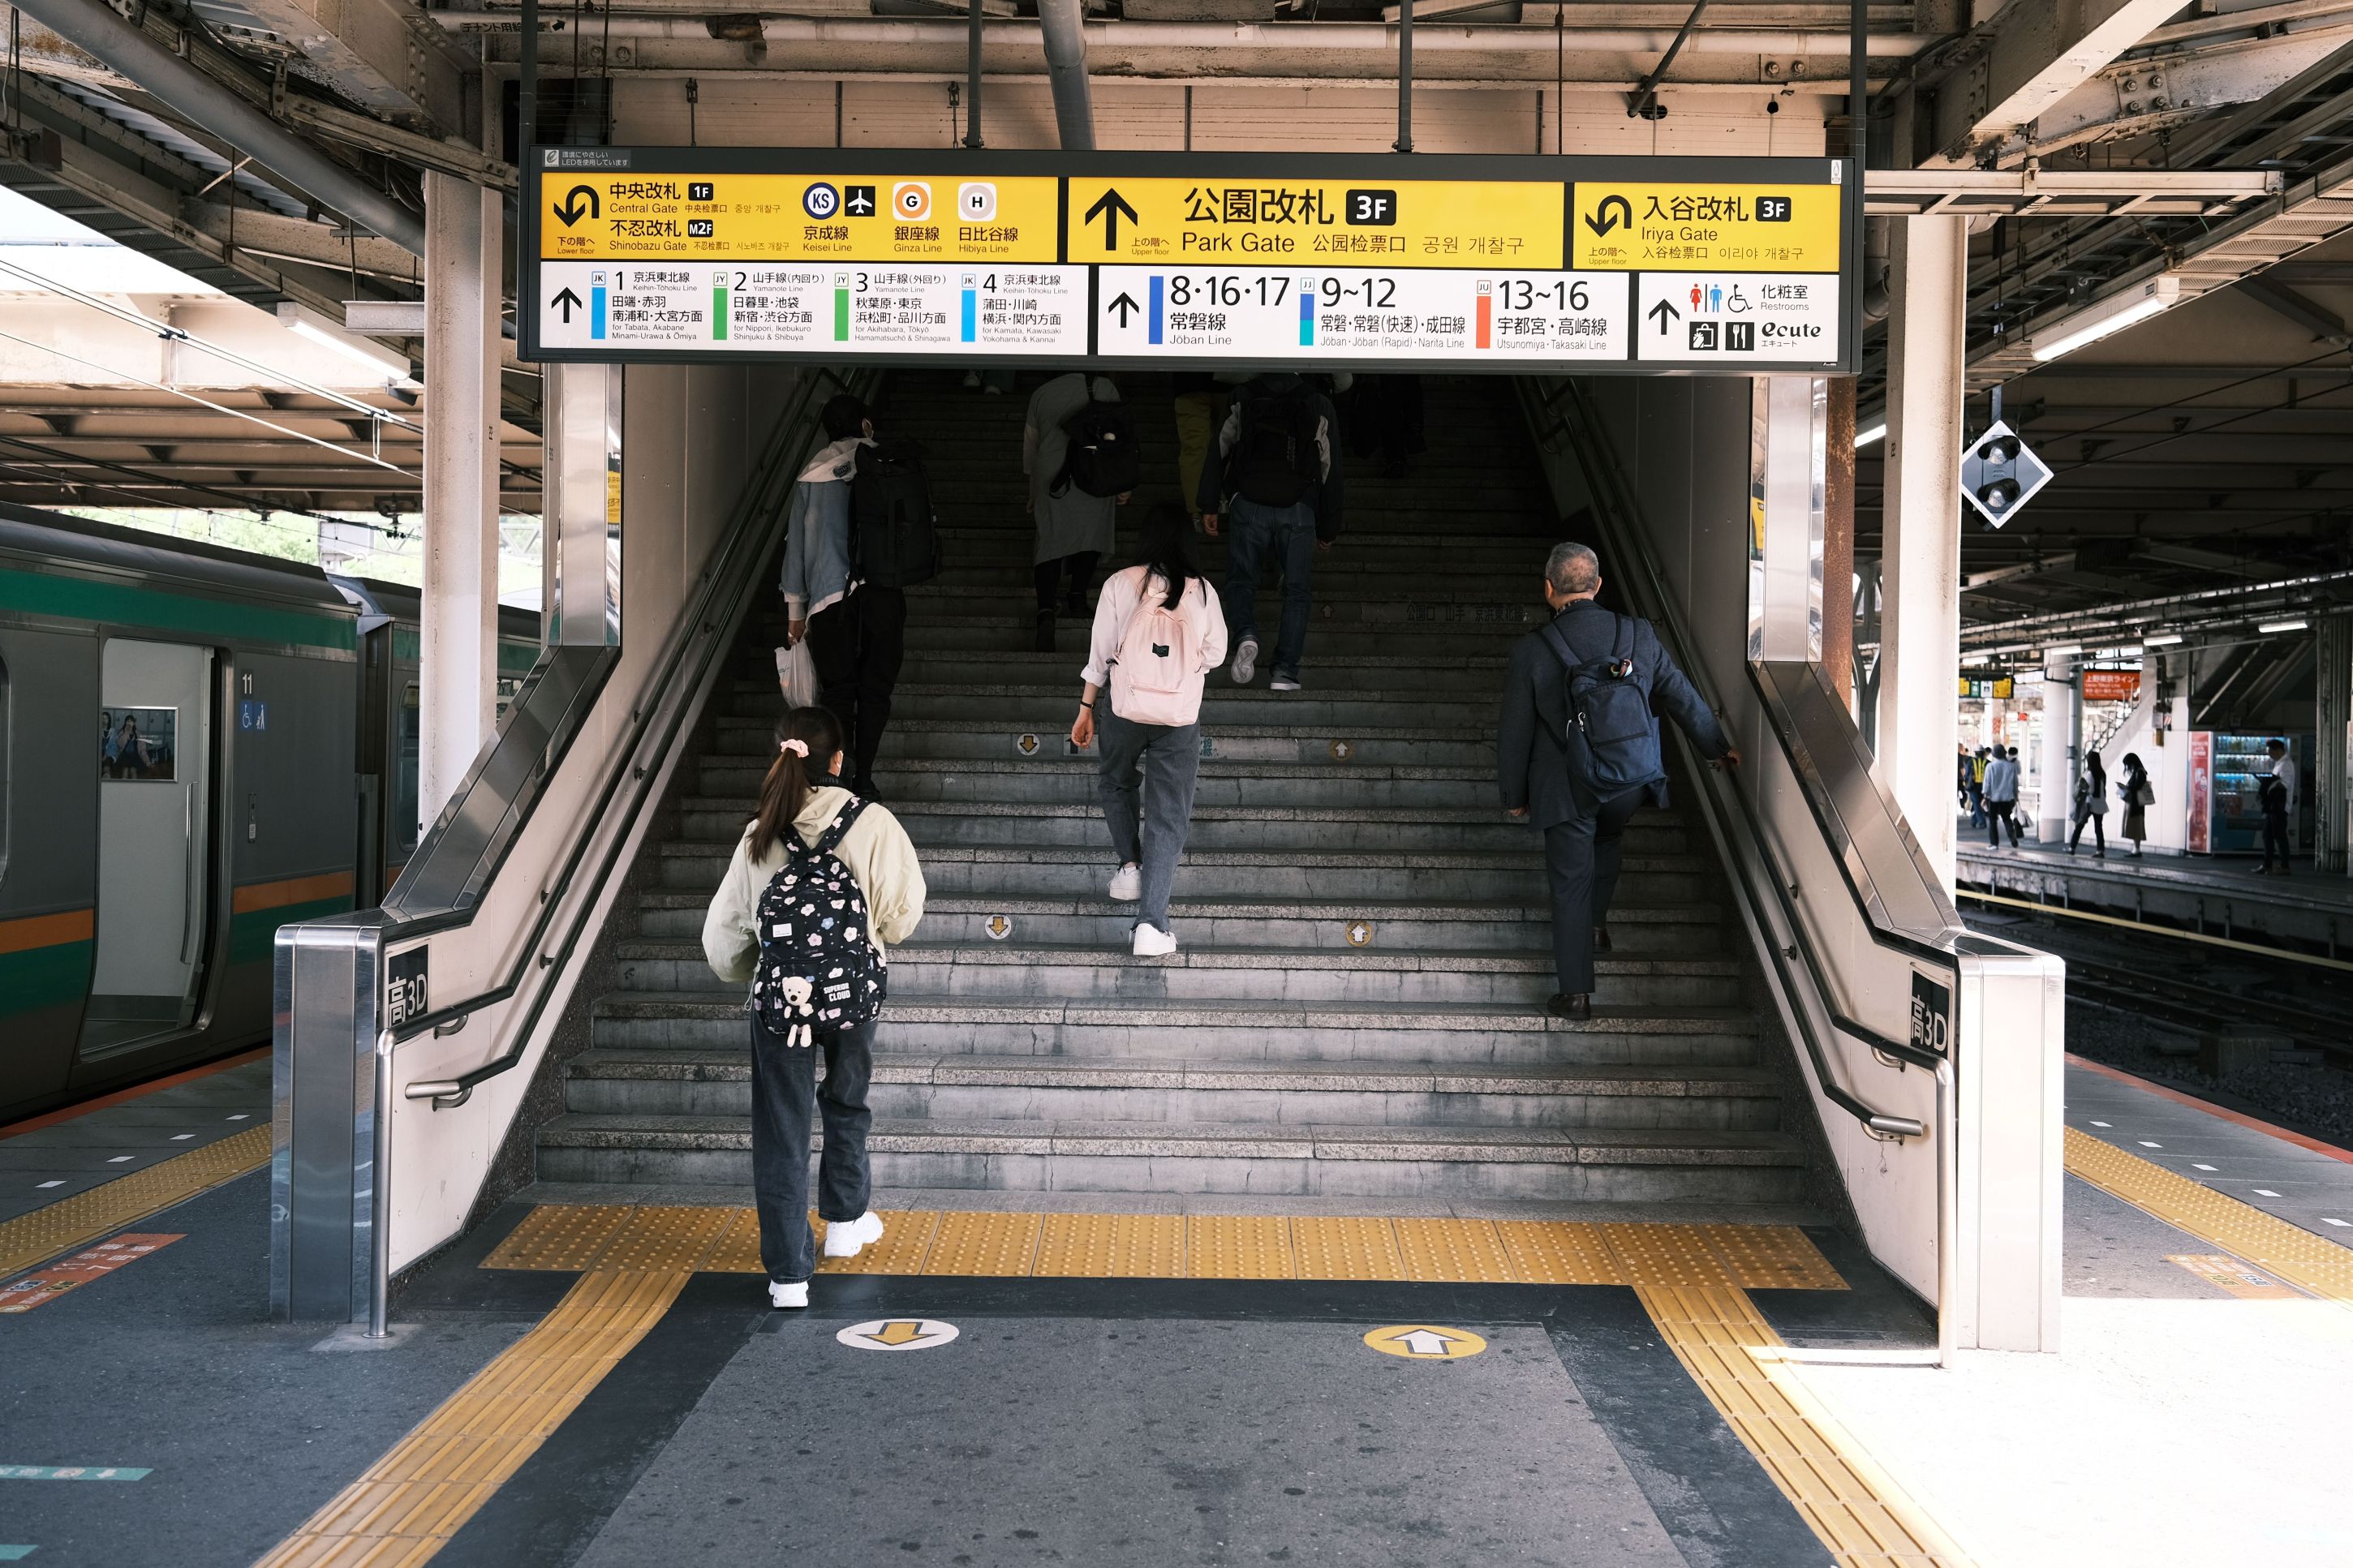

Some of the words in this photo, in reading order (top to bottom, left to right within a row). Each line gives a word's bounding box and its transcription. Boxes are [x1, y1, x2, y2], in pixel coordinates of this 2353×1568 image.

[610, 182, 681, 200] 中央改札
[694, 186, 709, 197] 1F
[812, 193, 829, 209] KS
[905, 195, 918, 208] G
[972, 196, 983, 208] H
[1184, 187, 1335, 226] 公園改札
[610, 203, 648, 214] Central
[652, 204, 678, 214] Gate
[685, 204, 728, 213] 中央检票口
[734, 204, 752, 213] 중앙
[755, 204, 781, 214] 개찰구
[1356, 195, 1387, 220] 3F
[1642, 195, 1749, 222] 入谷改札
[1762, 200, 1785, 218] 3F
[610, 219, 682, 238] 不忍改札
[689, 222, 712, 234] M2F
[803, 226, 849, 241] 京成線
[894, 226, 940, 241] 銀座線
[959, 227, 1018, 242] 日比谷線
[1641, 226, 1674, 244] Iriya
[1680, 227, 1718, 242] Gate
[557, 236, 595, 247] 下の階へ
[609, 240, 660, 251] Shinobazu
[664, 241, 687, 251] Gate
[803, 243, 830, 252] Keisei
[833, 243, 852, 252] Line
[894, 243, 922, 252] Ginza
[923, 244, 942, 252] Line
[1131, 237, 1170, 247] 上の階へ
[1182, 232, 1233, 252] Park
[1241, 232, 1295, 253] Gate
[1312, 234, 1405, 253] 公园检票口
[1422, 236, 1458, 255] 공원
[1469, 236, 1525, 256] 개찰구
[557, 247, 579, 255] Lower
[579, 247, 595, 255] floor
[959, 244, 987, 255] Hibiya
[990, 244, 1009, 253] Line
[1132, 248, 1152, 256] Upper
[1588, 247, 1627, 257] 上の階へ
[1641, 246, 1708, 260] 入谷检票口
[1719, 247, 1759, 260] 이리야
[1765, 247, 1805, 261] 개찰구
[1589, 258, 1610, 266] Upper
[594, 274, 604, 282] JK
[615, 272, 623, 290] 1
[633, 272, 690, 283] 京浜東北線
[716, 275, 725, 284] JY
[733, 272, 746, 291] 2
[837, 276, 846, 284] JY
[855, 273, 868, 292] 3
[964, 277, 974, 285] JK
[983, 274, 997, 293] 4
[1004, 274, 1060, 286] 京浜東北線
[1053, 287, 1069, 295] Line
[1479, 283, 1489, 291] JU
[1762, 284, 1808, 299] 化粧室
[613, 295, 666, 308] 田端・赤羽
[733, 296, 799, 309] 日暮里・池袋
[855, 297, 923, 310] 秋葉原・東京
[983, 299, 1037, 311] 蒲田・川崎
[1761, 302, 1809, 311] Restrooms
[612, 310, 703, 323] 南浦和・大宮方面
[733, 311, 812, 324] 新宿・渋谷方面
[855, 311, 946, 324] 浜松町・品川方面
[983, 312, 1061, 325] 横浜・関内方面
[1170, 312, 1227, 331] 常磐線
[624, 324, 651, 332] Tabata,
[746, 325, 773, 333] Nippori,
[994, 327, 1025, 335] Kamata,
[1498, 317, 1607, 336] 宇都宮・高崎線
[1762, 322, 1822, 337] ecute
[612, 332, 664, 340] Minami-Urawa
[733, 333, 764, 342] Shinjuku
[774, 333, 804, 342] Shibuya
[914, 335, 951, 343] Shinagawa
[1208, 335, 1232, 345] Line
[1447, 337, 1465, 348] Line
[1589, 340, 1607, 350] Line
[242, 673, 252, 694] 11
[823, 982, 850, 994] SUPERIOR
[828, 990, 851, 1002] CLOUD
